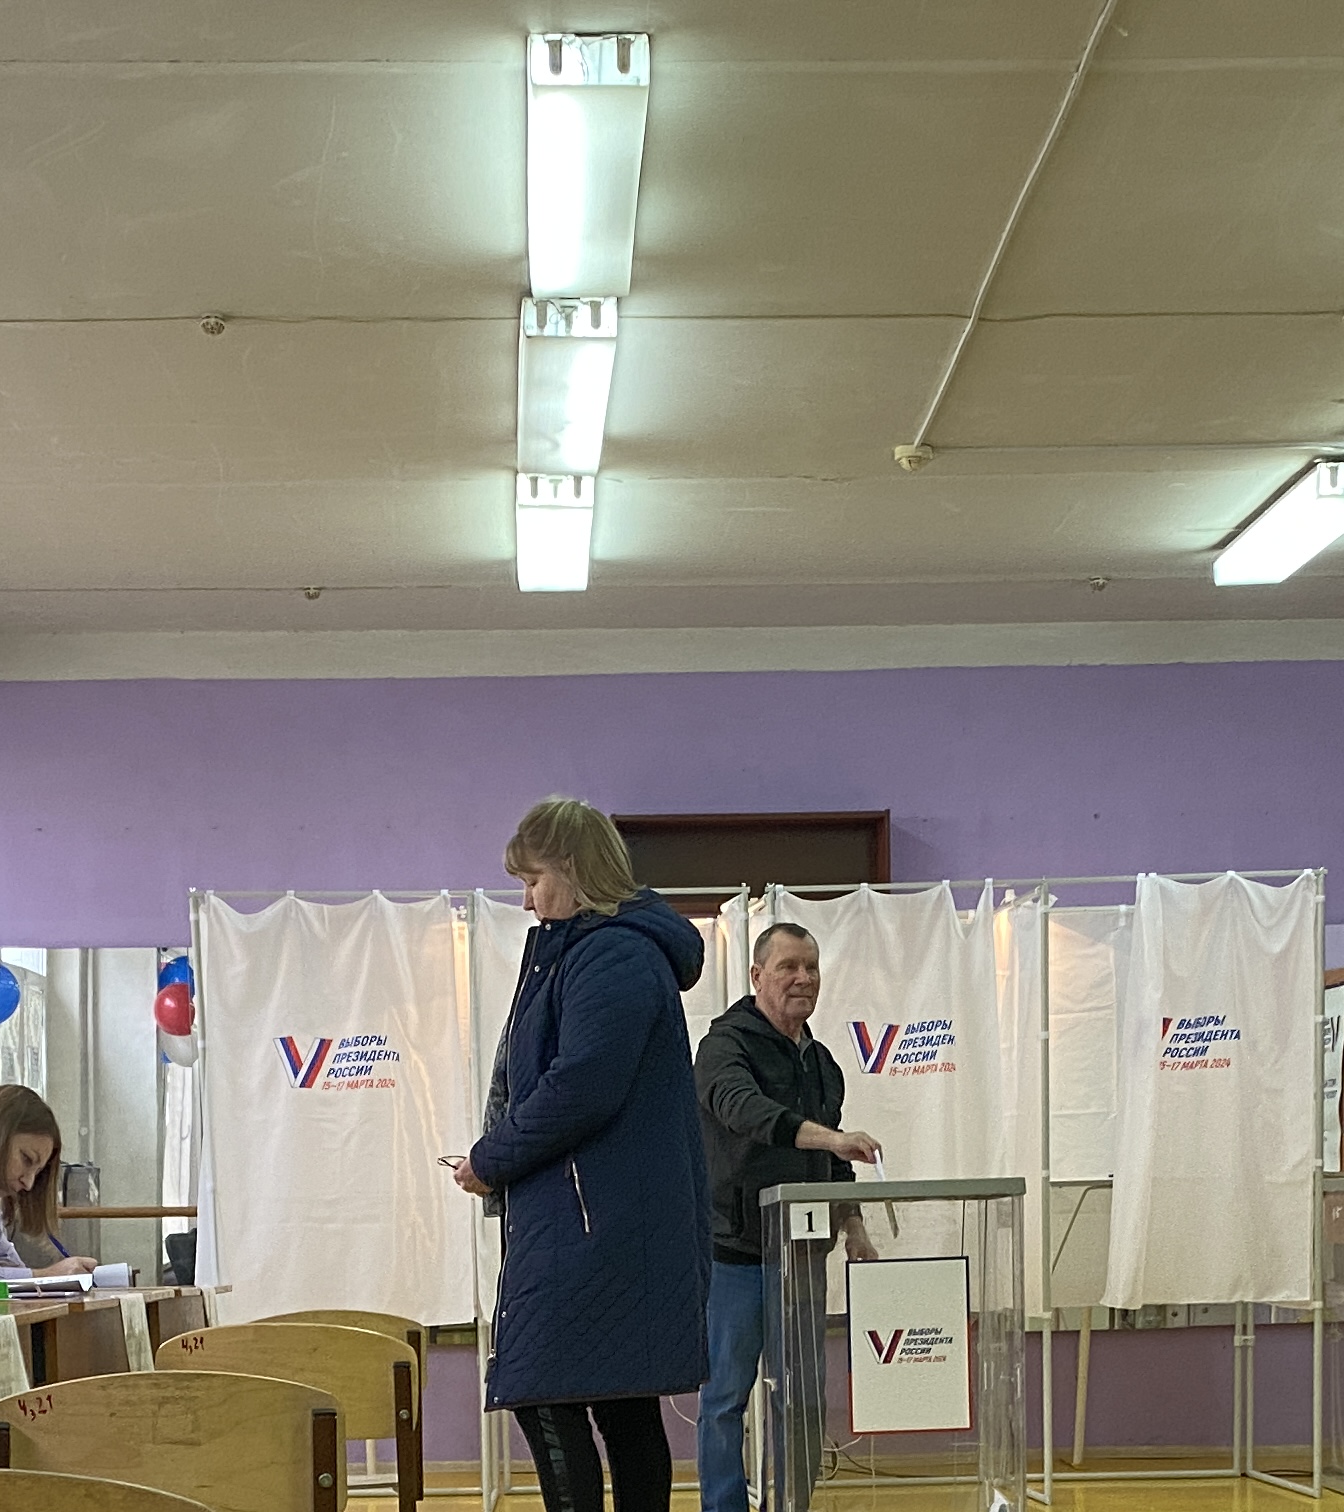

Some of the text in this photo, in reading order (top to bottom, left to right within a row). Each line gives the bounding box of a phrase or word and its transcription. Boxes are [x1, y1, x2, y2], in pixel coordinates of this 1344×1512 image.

[904, 1019, 953, 1036] ВЫБОРЫ
[338, 1034, 388, 1050] ВЫБОРЫ
[897, 1034, 956, 1051] ПРЕЗИДЕН
[1169, 1029, 1241, 1044] ПРЕЗИДЕНТА
[331, 1049, 400, 1065] ПРЕЗИДЕНТА
[892, 1049, 938, 1065] РОССИИ
[1162, 1045, 1210, 1058] РОССИИ
[326, 1065, 373, 1078] РОССИИ
[345, 1078, 374, 1090] МАРТА
[375, 1077, 396, 1089] 2024
[804, 1210, 816, 1233] 1
[907, 1327, 943, 1337] ВЫБОРЫ
[903, 1336, 954, 1346] ПРЕЗИДЕНТА
[899, 1347, 932, 1356] РОССИИ
